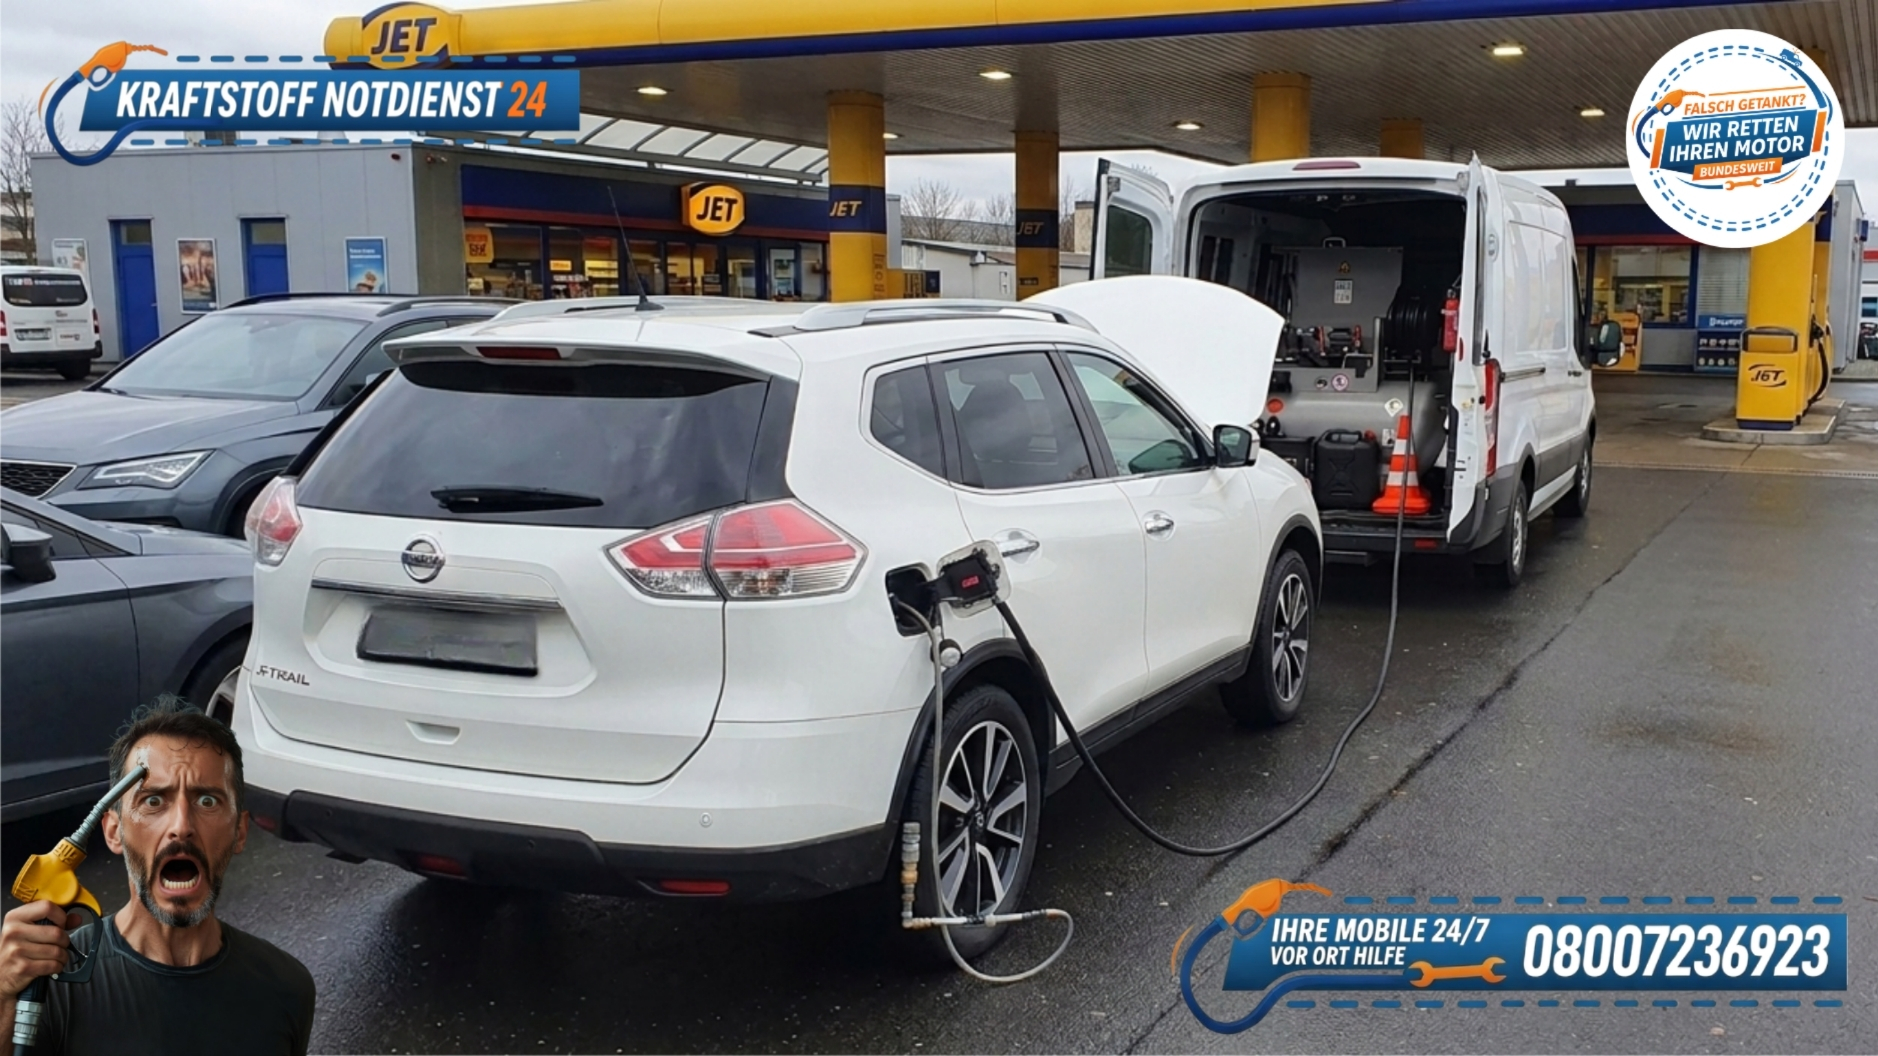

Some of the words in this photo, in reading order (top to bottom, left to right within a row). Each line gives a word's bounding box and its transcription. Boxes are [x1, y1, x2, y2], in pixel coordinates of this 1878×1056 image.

[371, 17, 437, 55] JET
[696, 196, 738, 222] JET
[830, 200, 862, 217] JET
